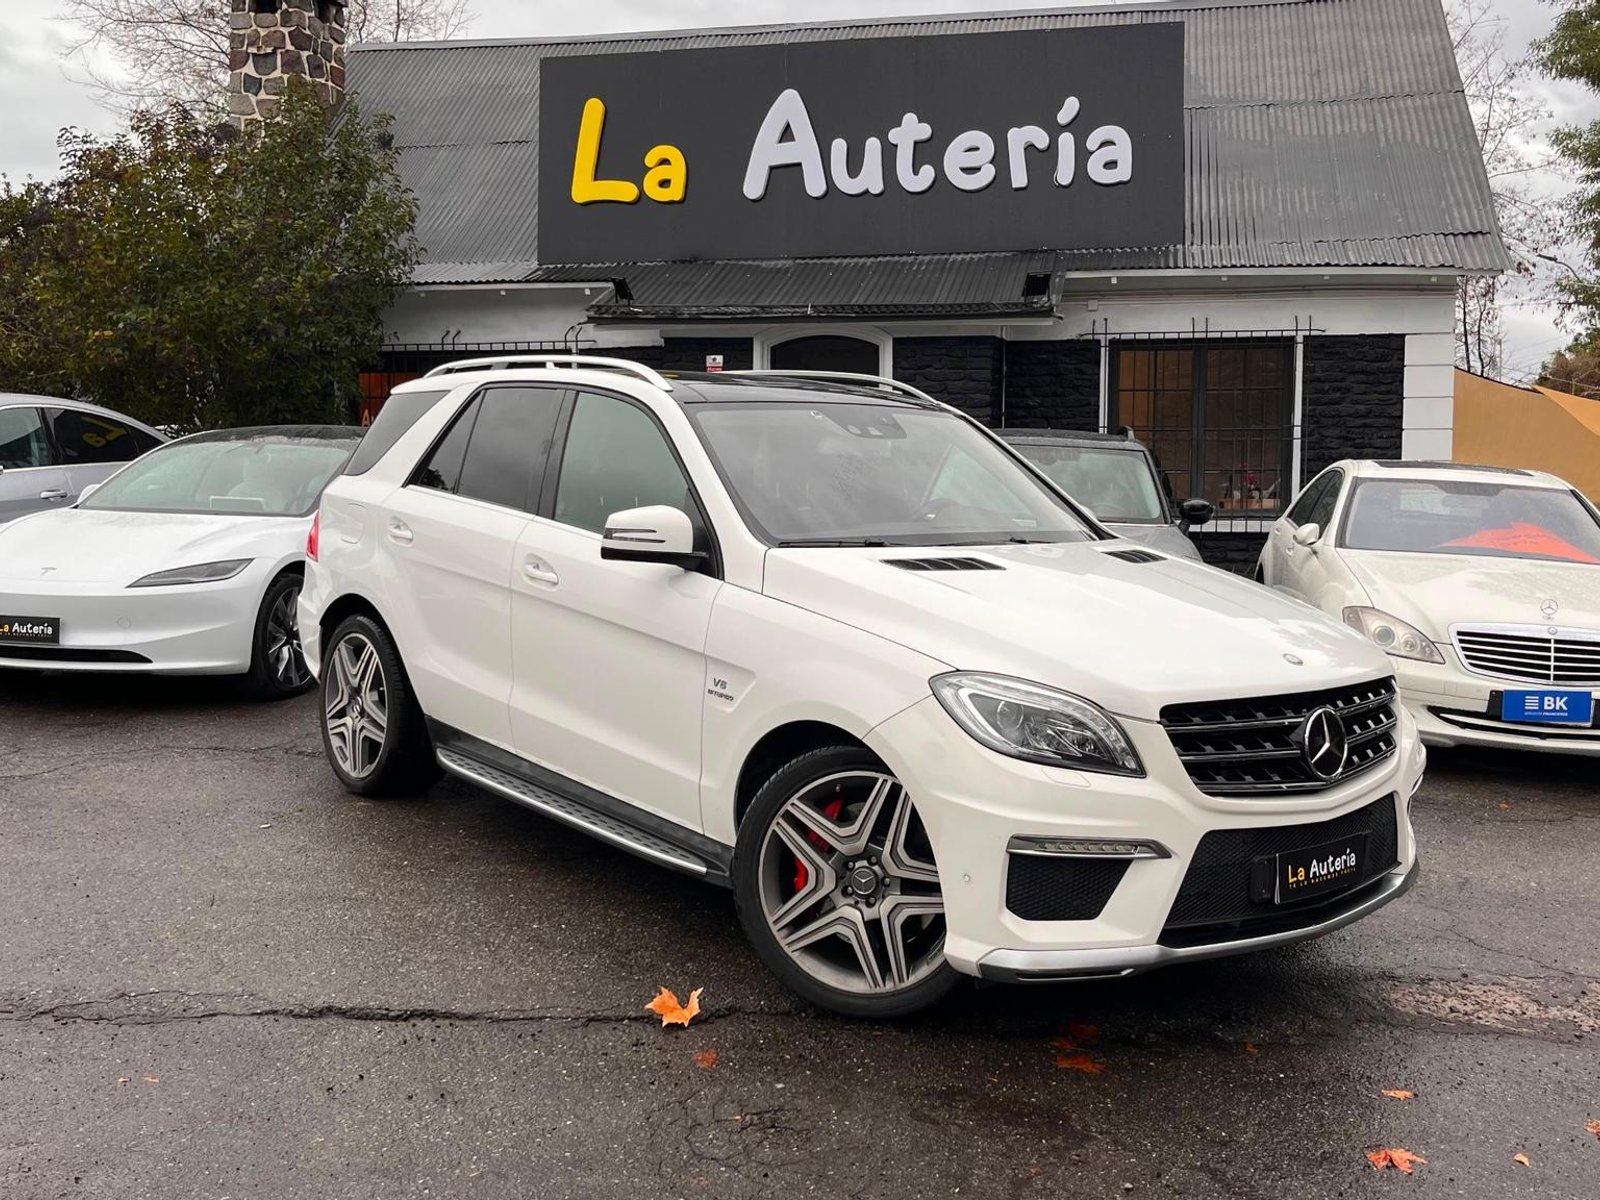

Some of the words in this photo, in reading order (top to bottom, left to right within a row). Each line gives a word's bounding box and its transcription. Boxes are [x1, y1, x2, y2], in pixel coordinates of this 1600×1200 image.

[571, 97, 687, 204] La
[742, 88, 1134, 201] Autería
[12, 622, 53, 634] Autería
[1543, 696, 1568, 710] BK
[1288, 865, 1305, 884] La
[1309, 848, 1356, 878] Autería
